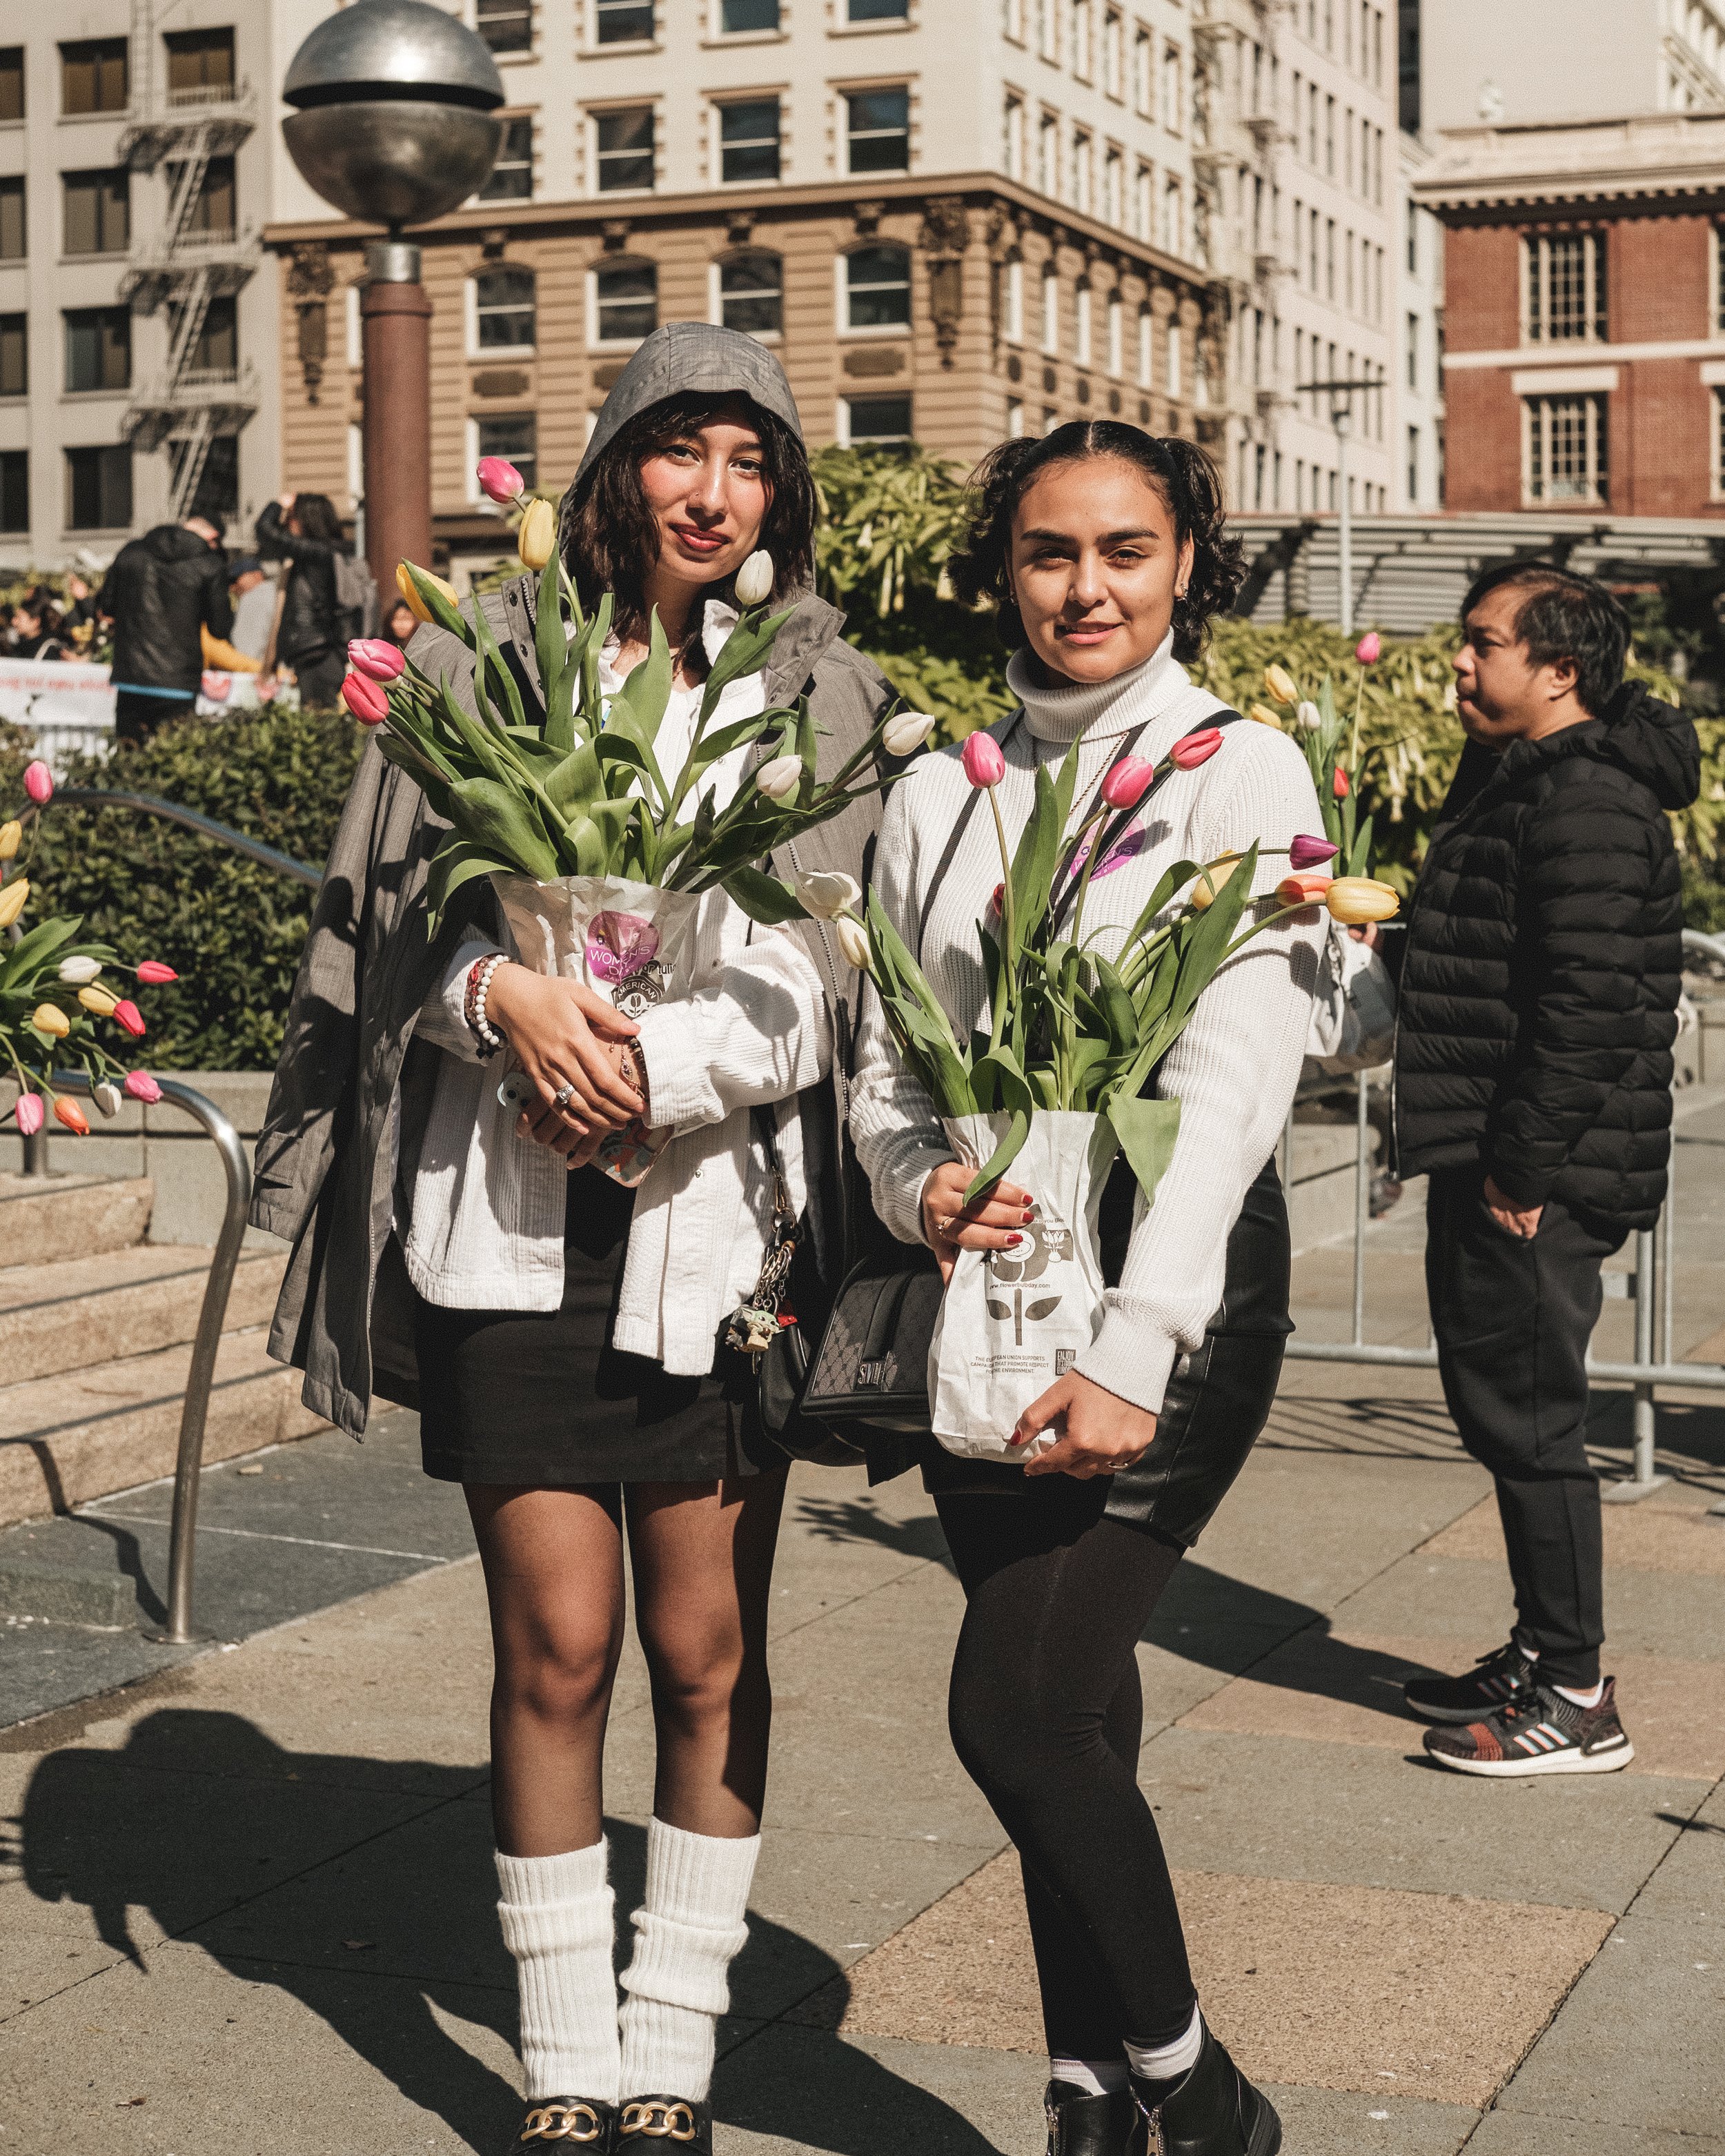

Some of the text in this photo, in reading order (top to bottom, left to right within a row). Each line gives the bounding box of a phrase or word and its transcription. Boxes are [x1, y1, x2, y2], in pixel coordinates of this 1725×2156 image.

[618, 981, 657, 1000] AMERICAN
[986, 1354, 1006, 1363] EUPEAN
[1058, 1350, 1074, 1361] ENJOY
